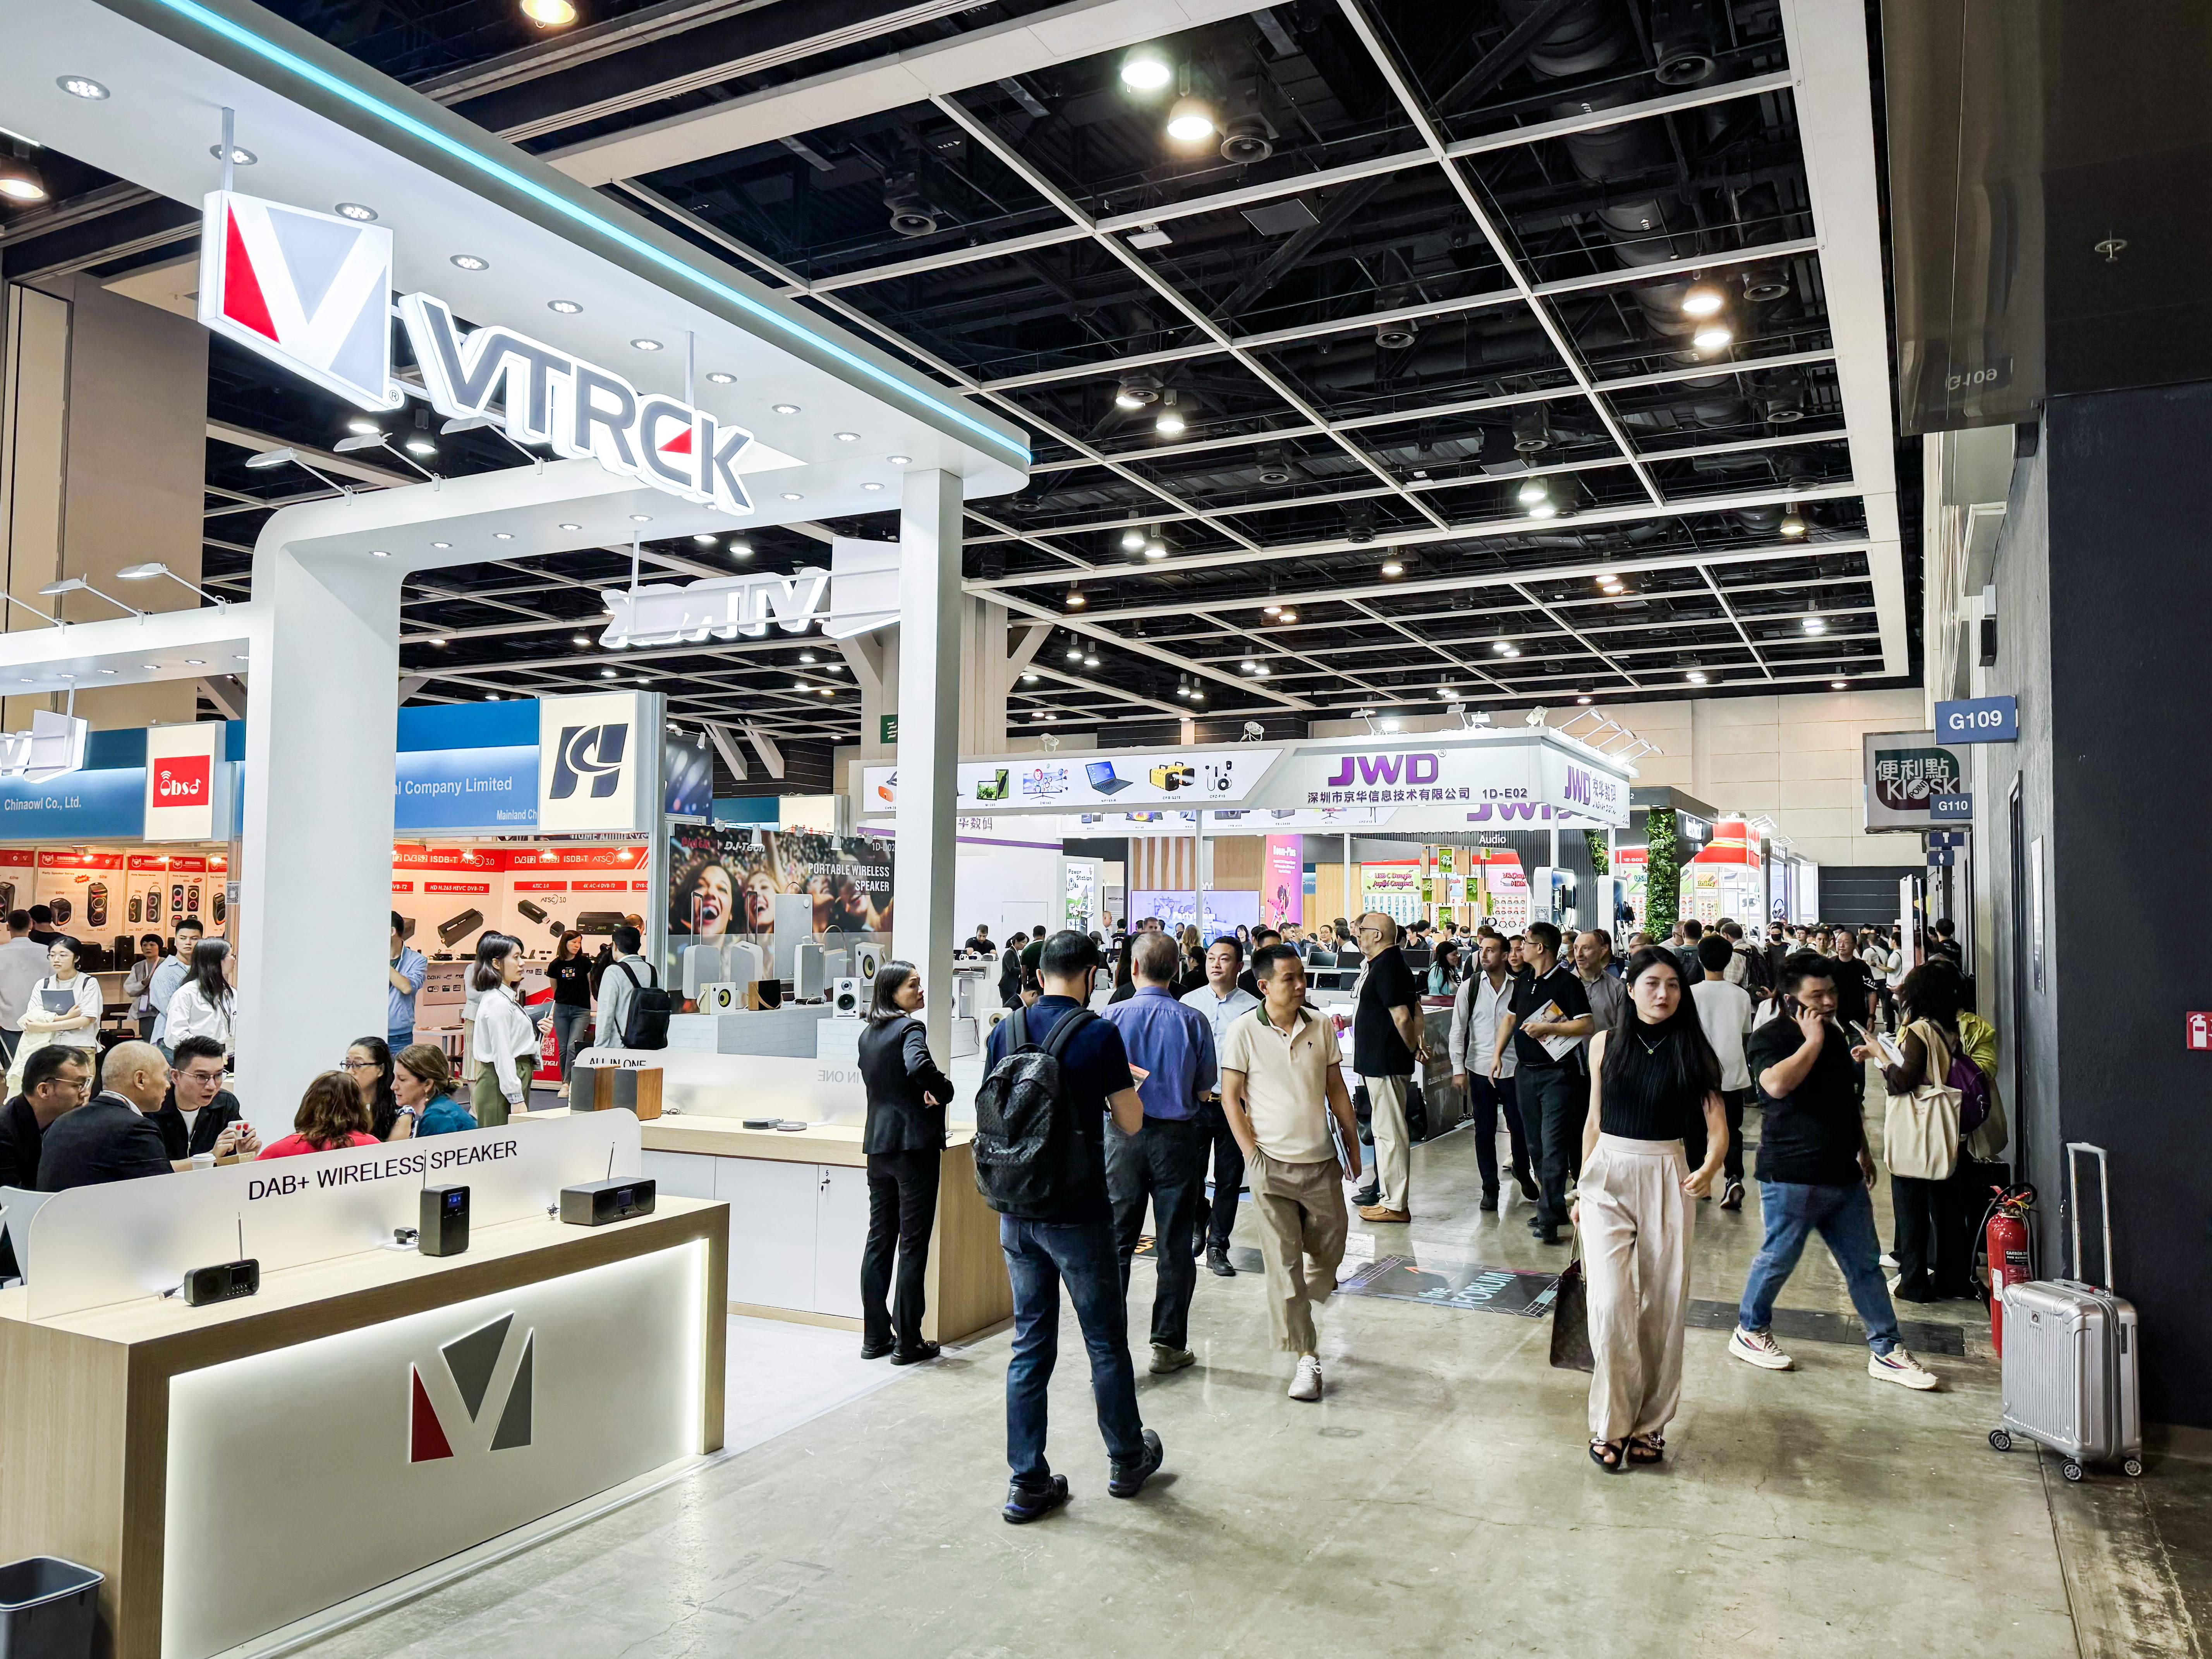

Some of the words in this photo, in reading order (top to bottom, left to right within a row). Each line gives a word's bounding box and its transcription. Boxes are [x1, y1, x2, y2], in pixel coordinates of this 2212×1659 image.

[1949, 710, 2002, 730] G109
[1328, 754, 1438, 787] JWD
[1875, 758, 1949, 781] 便利點
[405, 780, 462, 797] Company
[466, 776, 512, 792] Limited
[1564, 765, 1590, 805] JWD
[1909, 780, 1927, 798] POINT
[1307, 788, 1470, 804] 深圳市京华信息技术有限公司
[1482, 788, 1528, 800] 1D-E02
[4, 797, 43, 811] Chinaowl
[45, 797, 62, 810] Co.,
[65, 796, 81, 809] Ltd.
[1939, 800, 1968, 811] G110
[497, 810, 526, 820] Mainland
[1479, 835, 1506, 844] Audio
[808, 863, 850, 875] PORTABLE
[852, 865, 890, 877] WIRELESS
[855, 880, 890, 891] SPEAKER
[249, 1175, 309, 1200] DAB+
[317, 1155, 424, 1188] WIRELESS
[431, 1140, 517, 1169] SPEAKER
[1450, 1271, 1517, 1305] FORUM
